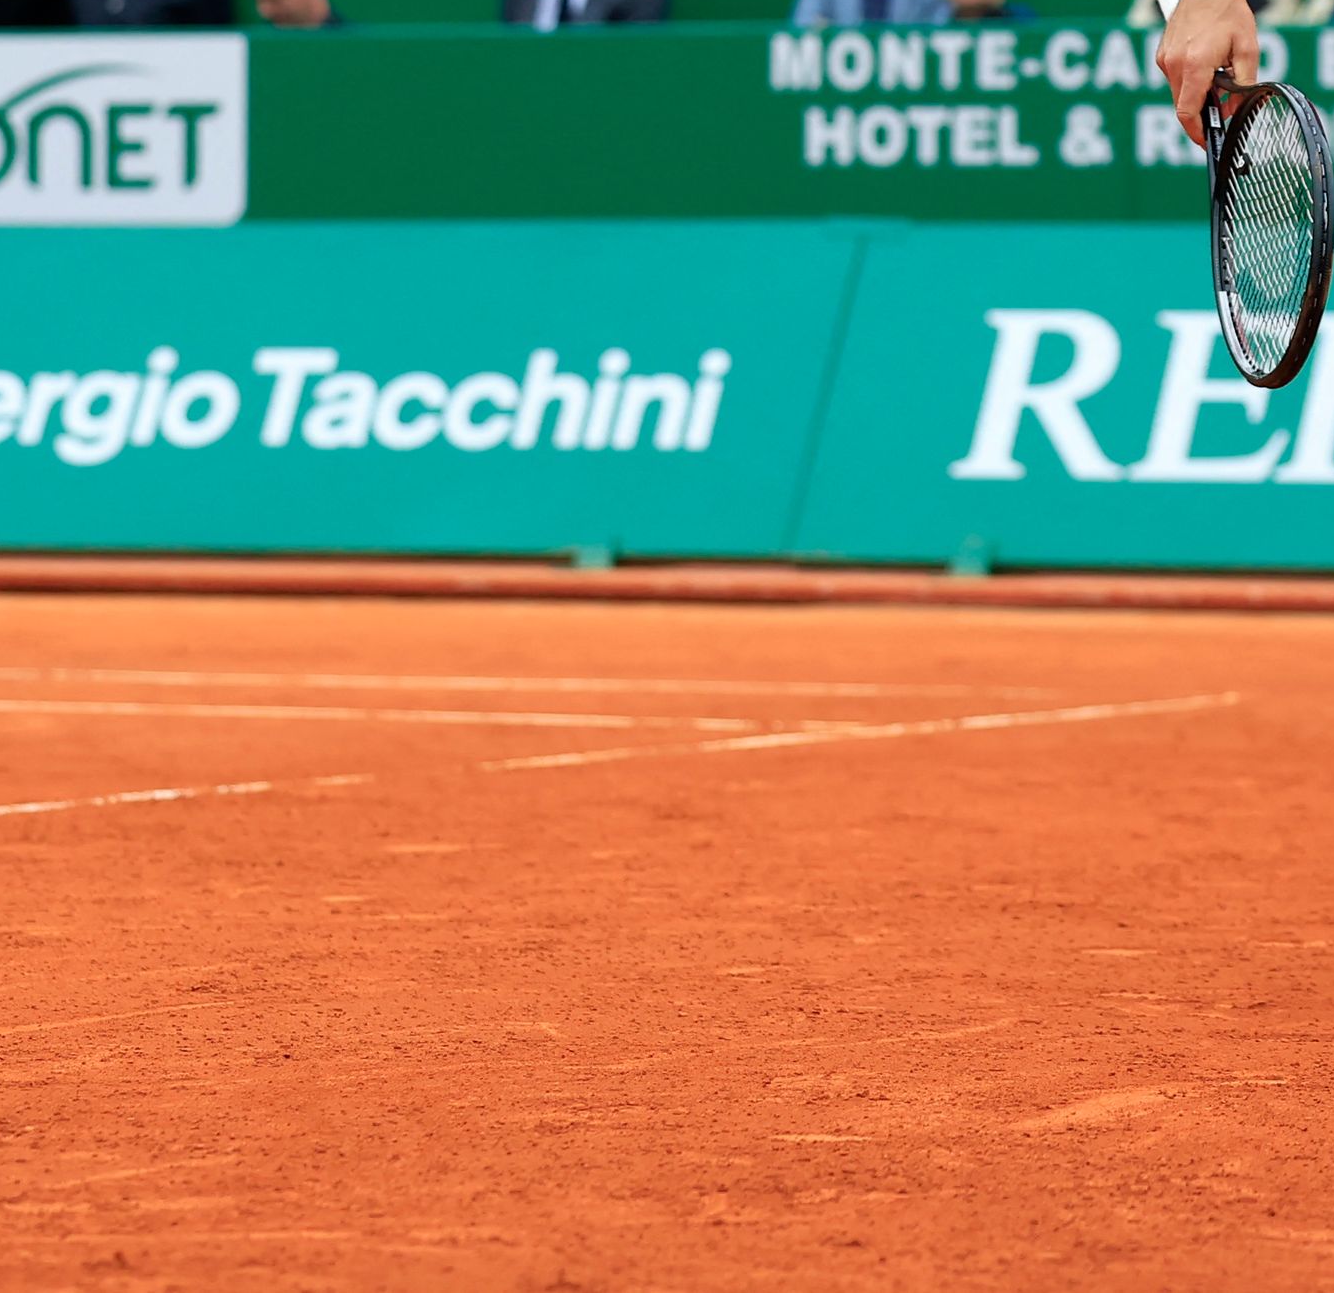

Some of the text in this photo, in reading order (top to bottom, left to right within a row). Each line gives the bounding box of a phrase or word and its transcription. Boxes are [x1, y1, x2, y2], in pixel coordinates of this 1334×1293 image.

[770, 30, 1289, 91] MONTE-CAO
[804, 105, 1040, 167] HOTEL
[1060, 105, 1114, 166] &
[253, 345, 733, 453] Tacchini
